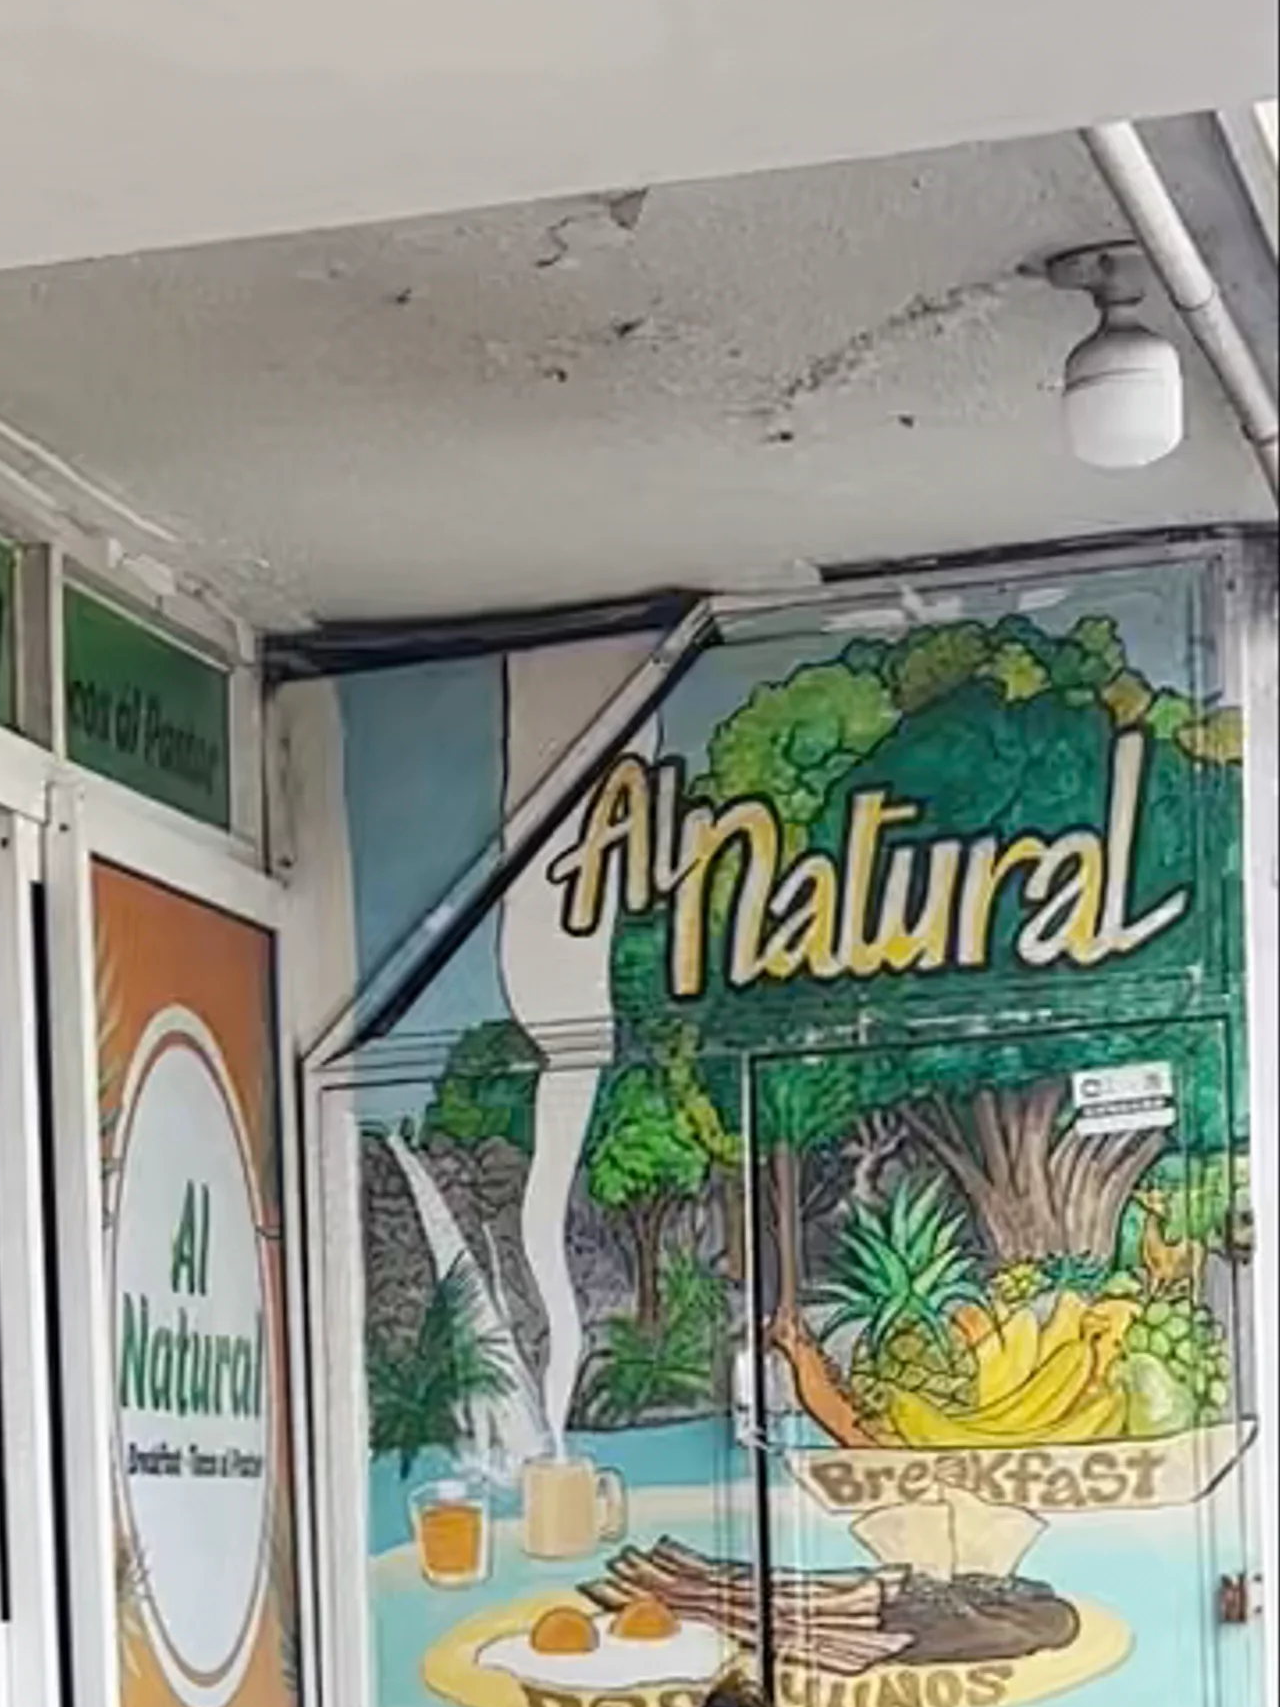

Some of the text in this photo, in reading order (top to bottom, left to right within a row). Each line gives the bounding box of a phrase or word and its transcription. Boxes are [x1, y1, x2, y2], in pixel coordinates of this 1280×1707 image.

[547, 752, 690, 936] Al
[170, 1179, 211, 1297] Al
[119, 1291, 263, 1419] Natural
